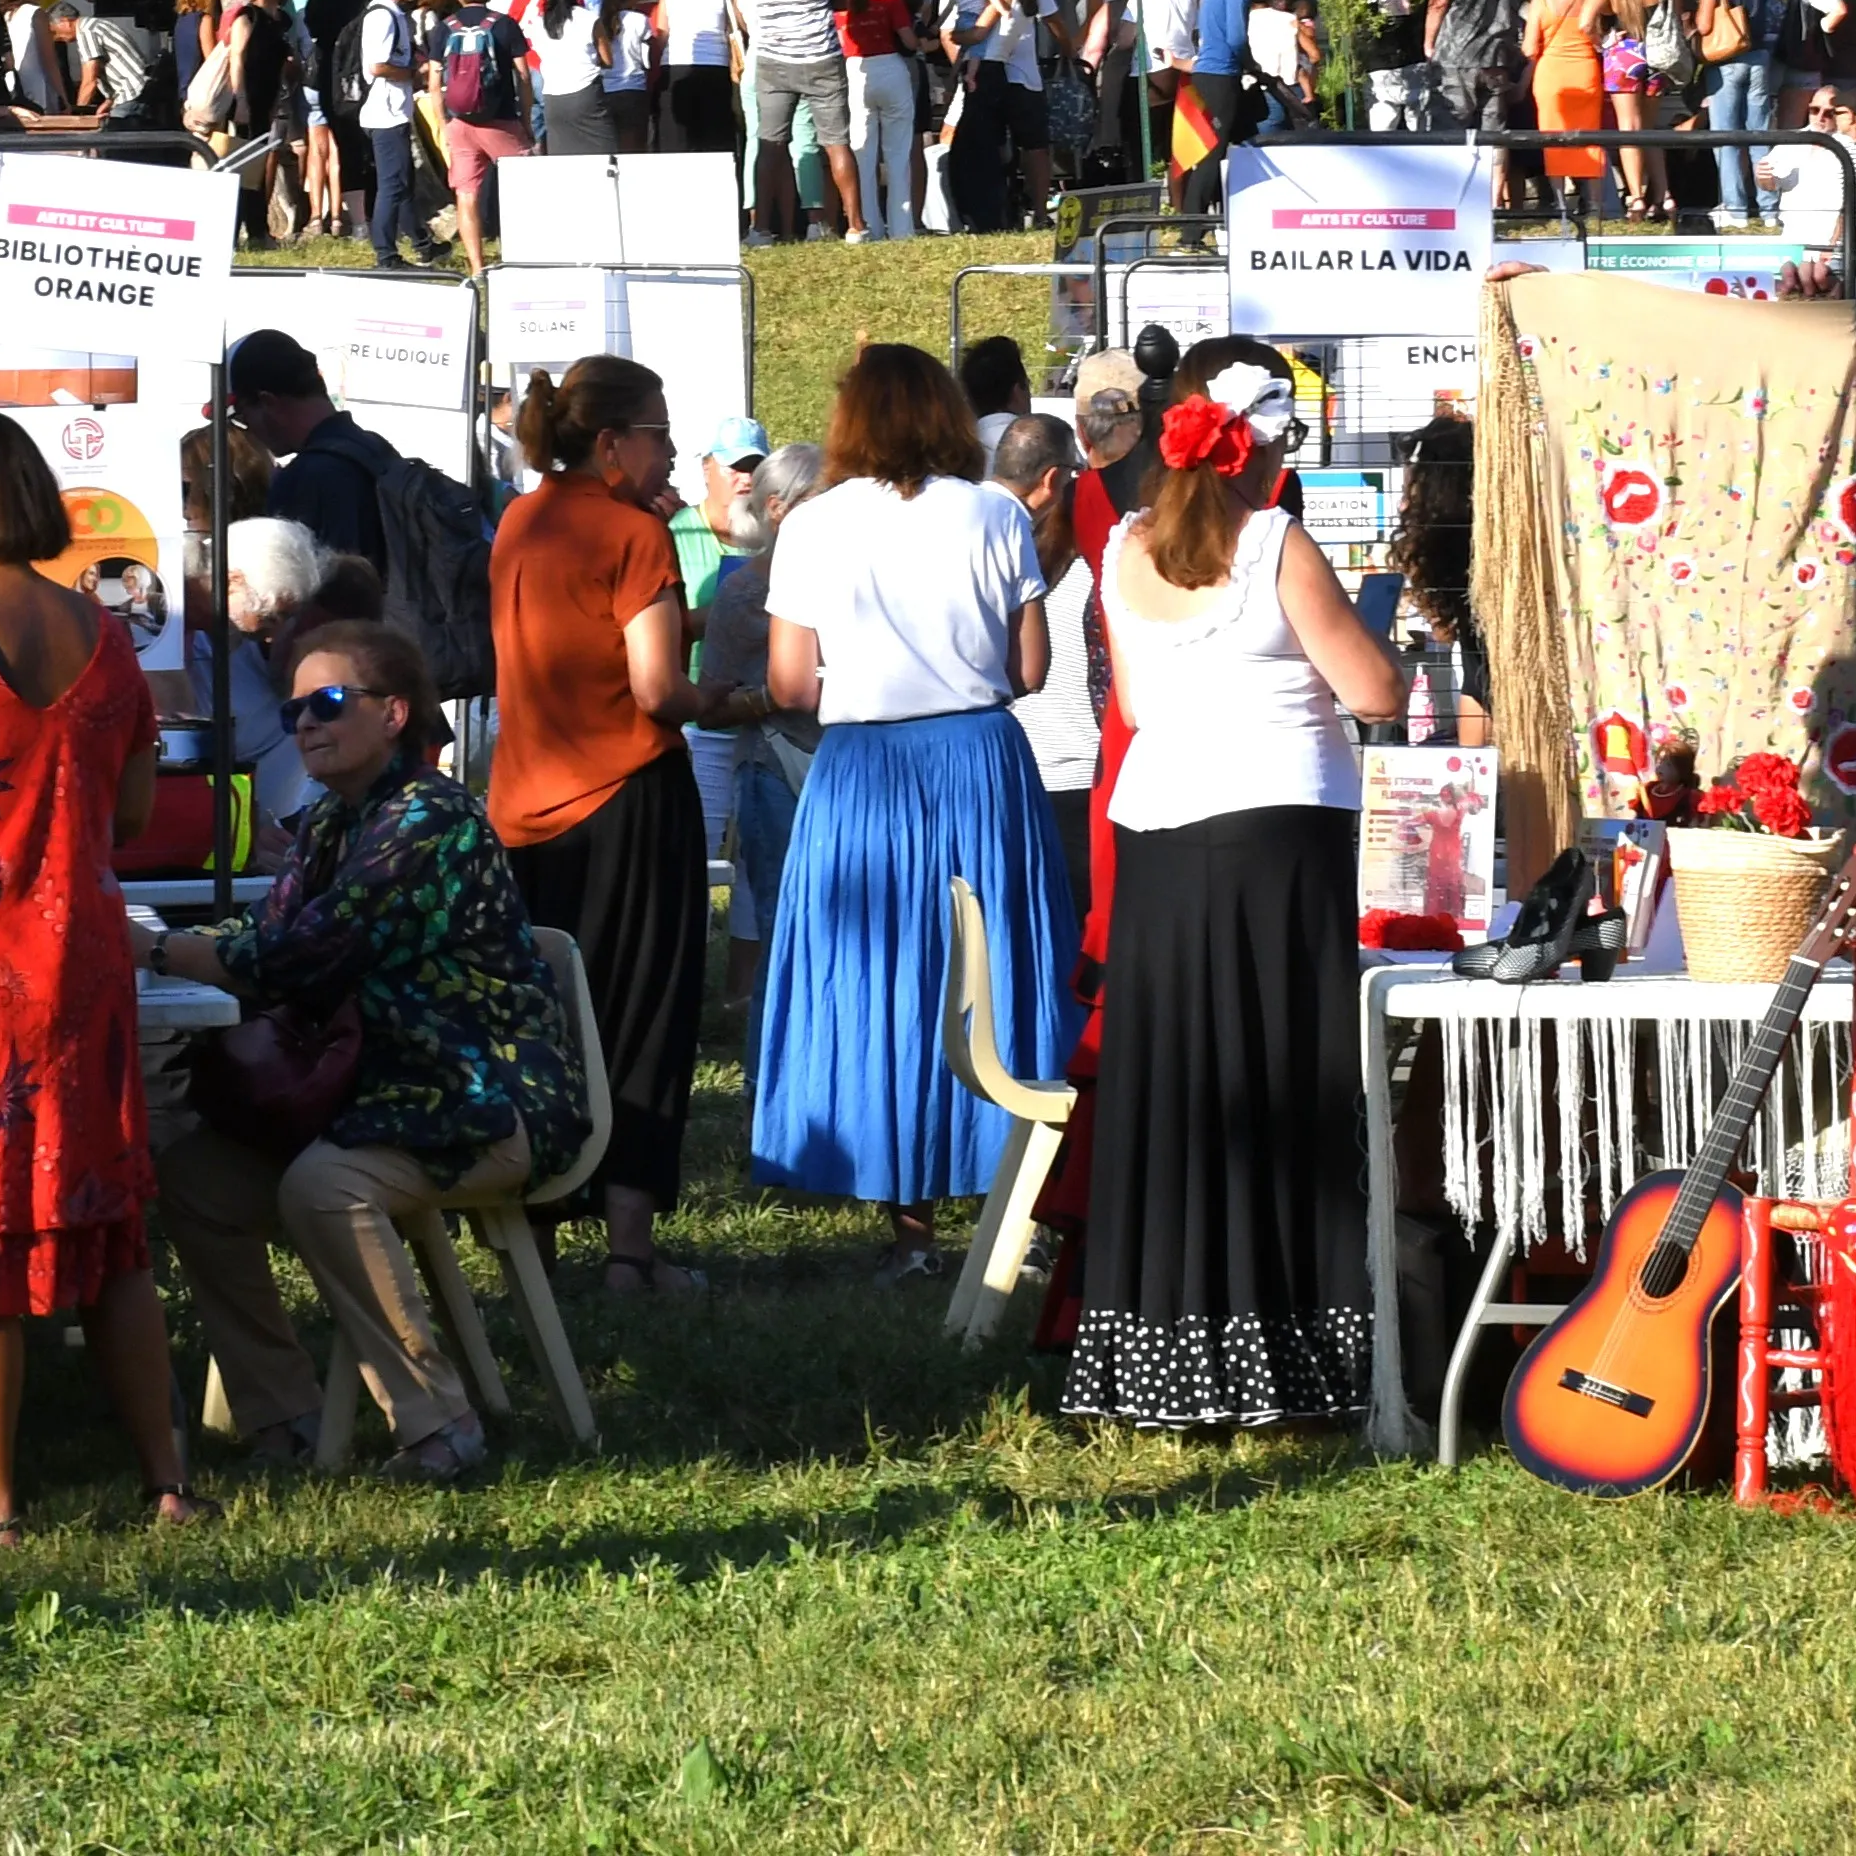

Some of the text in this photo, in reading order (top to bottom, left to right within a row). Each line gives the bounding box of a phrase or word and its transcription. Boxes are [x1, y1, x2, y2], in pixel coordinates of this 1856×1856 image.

[35, 211, 166, 235] ARTS ET CULTURE
[1300, 214, 1429, 226] ARTS ET CULTURE
[1250, 250, 1473, 272] BAILAR LA VIDA
[33, 276, 155, 307] ORANGE
[519, 320, 576, 333] SOLIANE
[375, 346, 451, 367] LUDIQUE
[1406, 345, 1477, 364] ENCH
[1303, 500, 1369, 511] OCIATION
